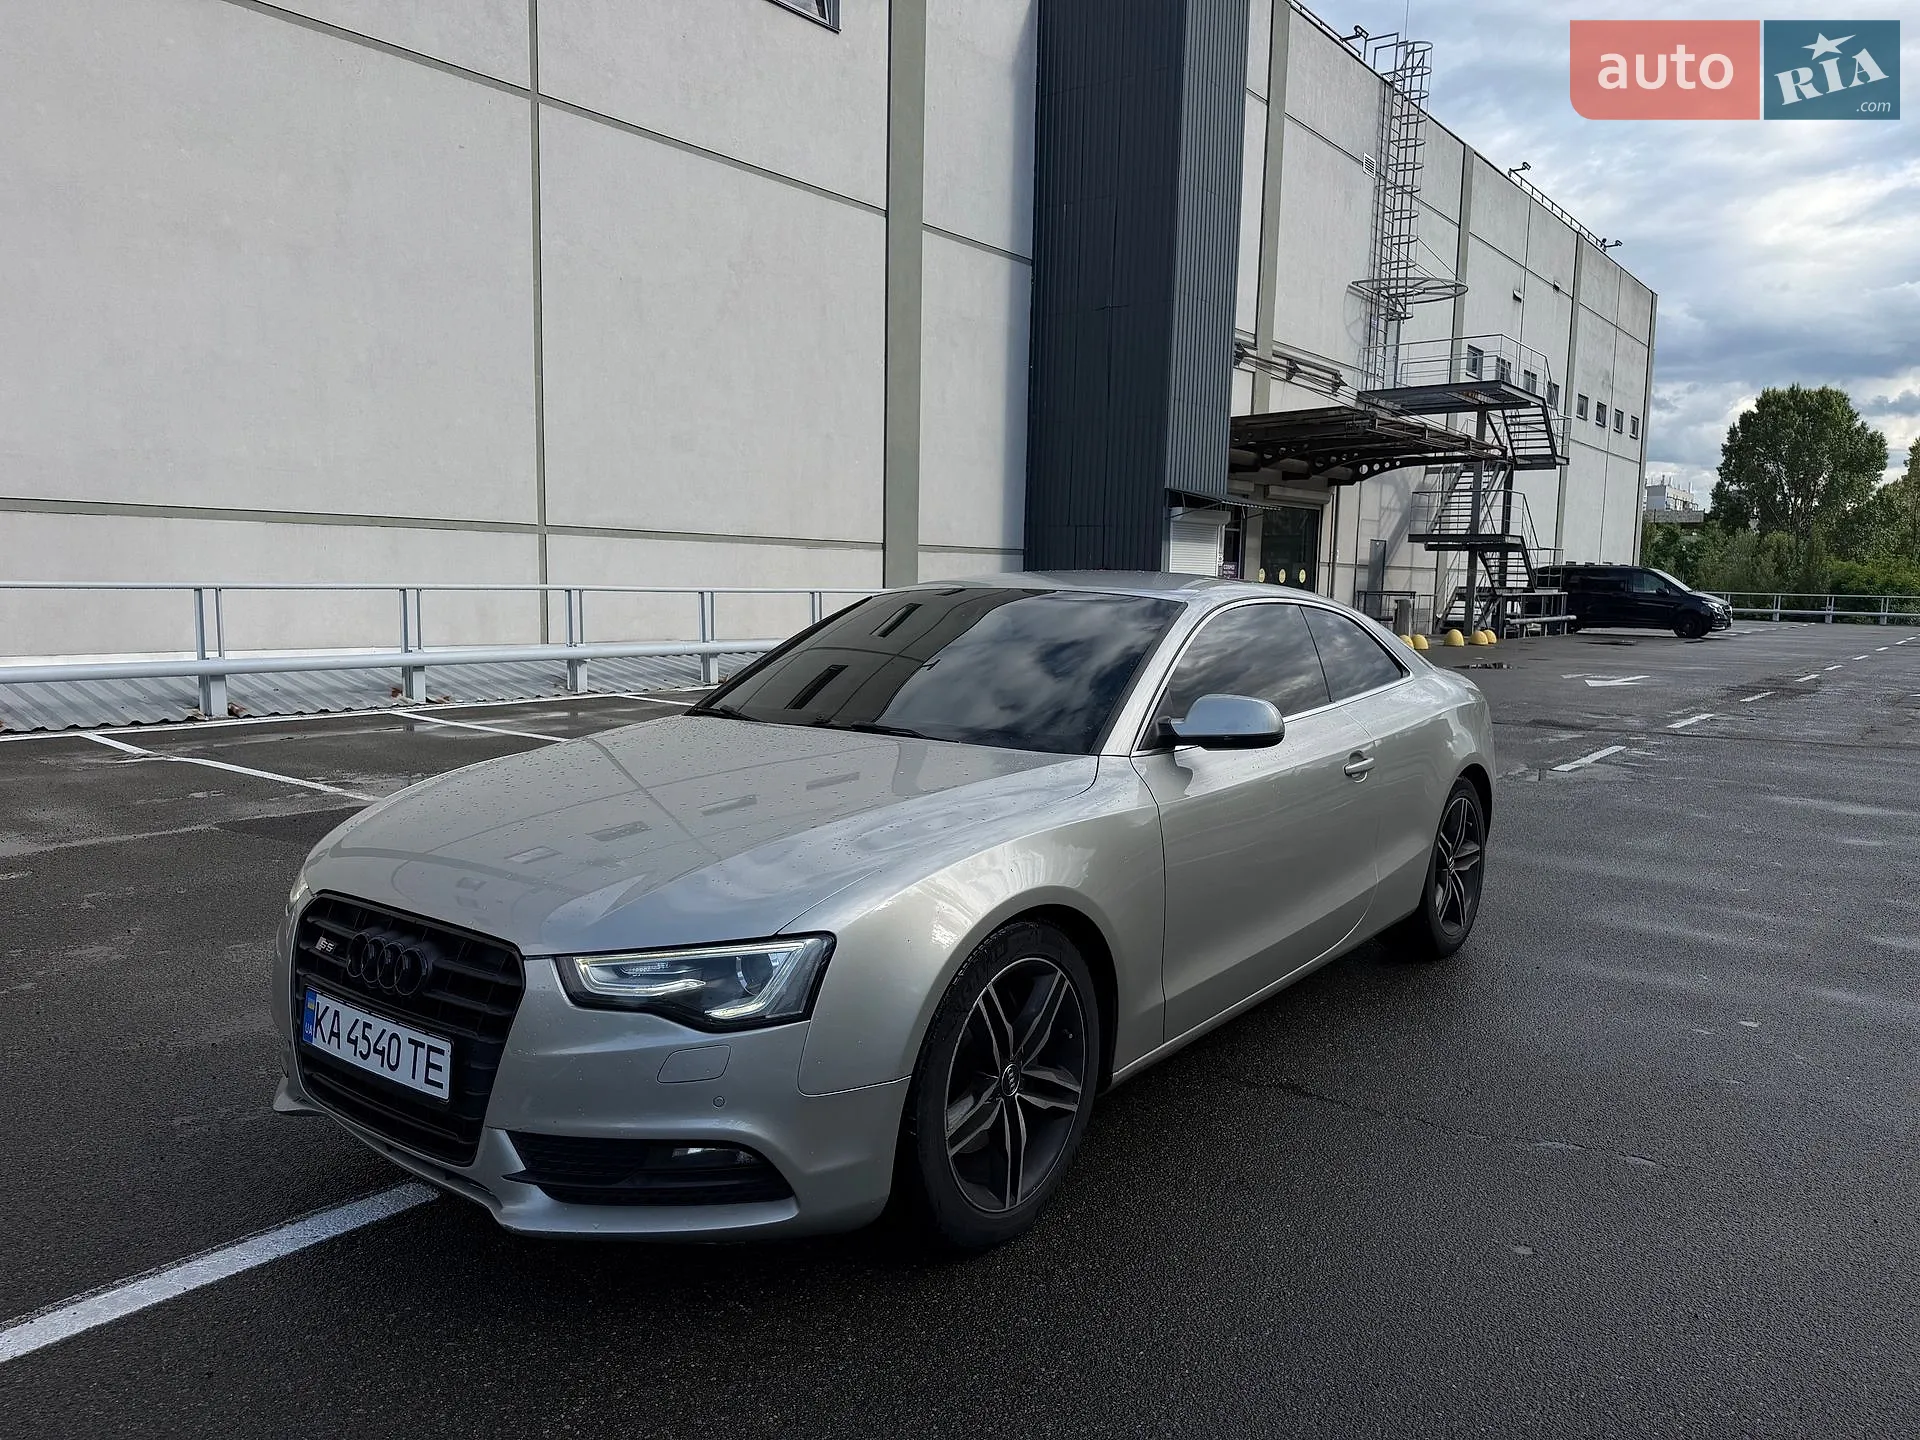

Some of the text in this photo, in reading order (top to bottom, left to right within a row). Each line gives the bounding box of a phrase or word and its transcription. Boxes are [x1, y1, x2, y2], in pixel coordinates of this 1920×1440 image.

[314, 1001, 445, 1090] KA 4540 TE
